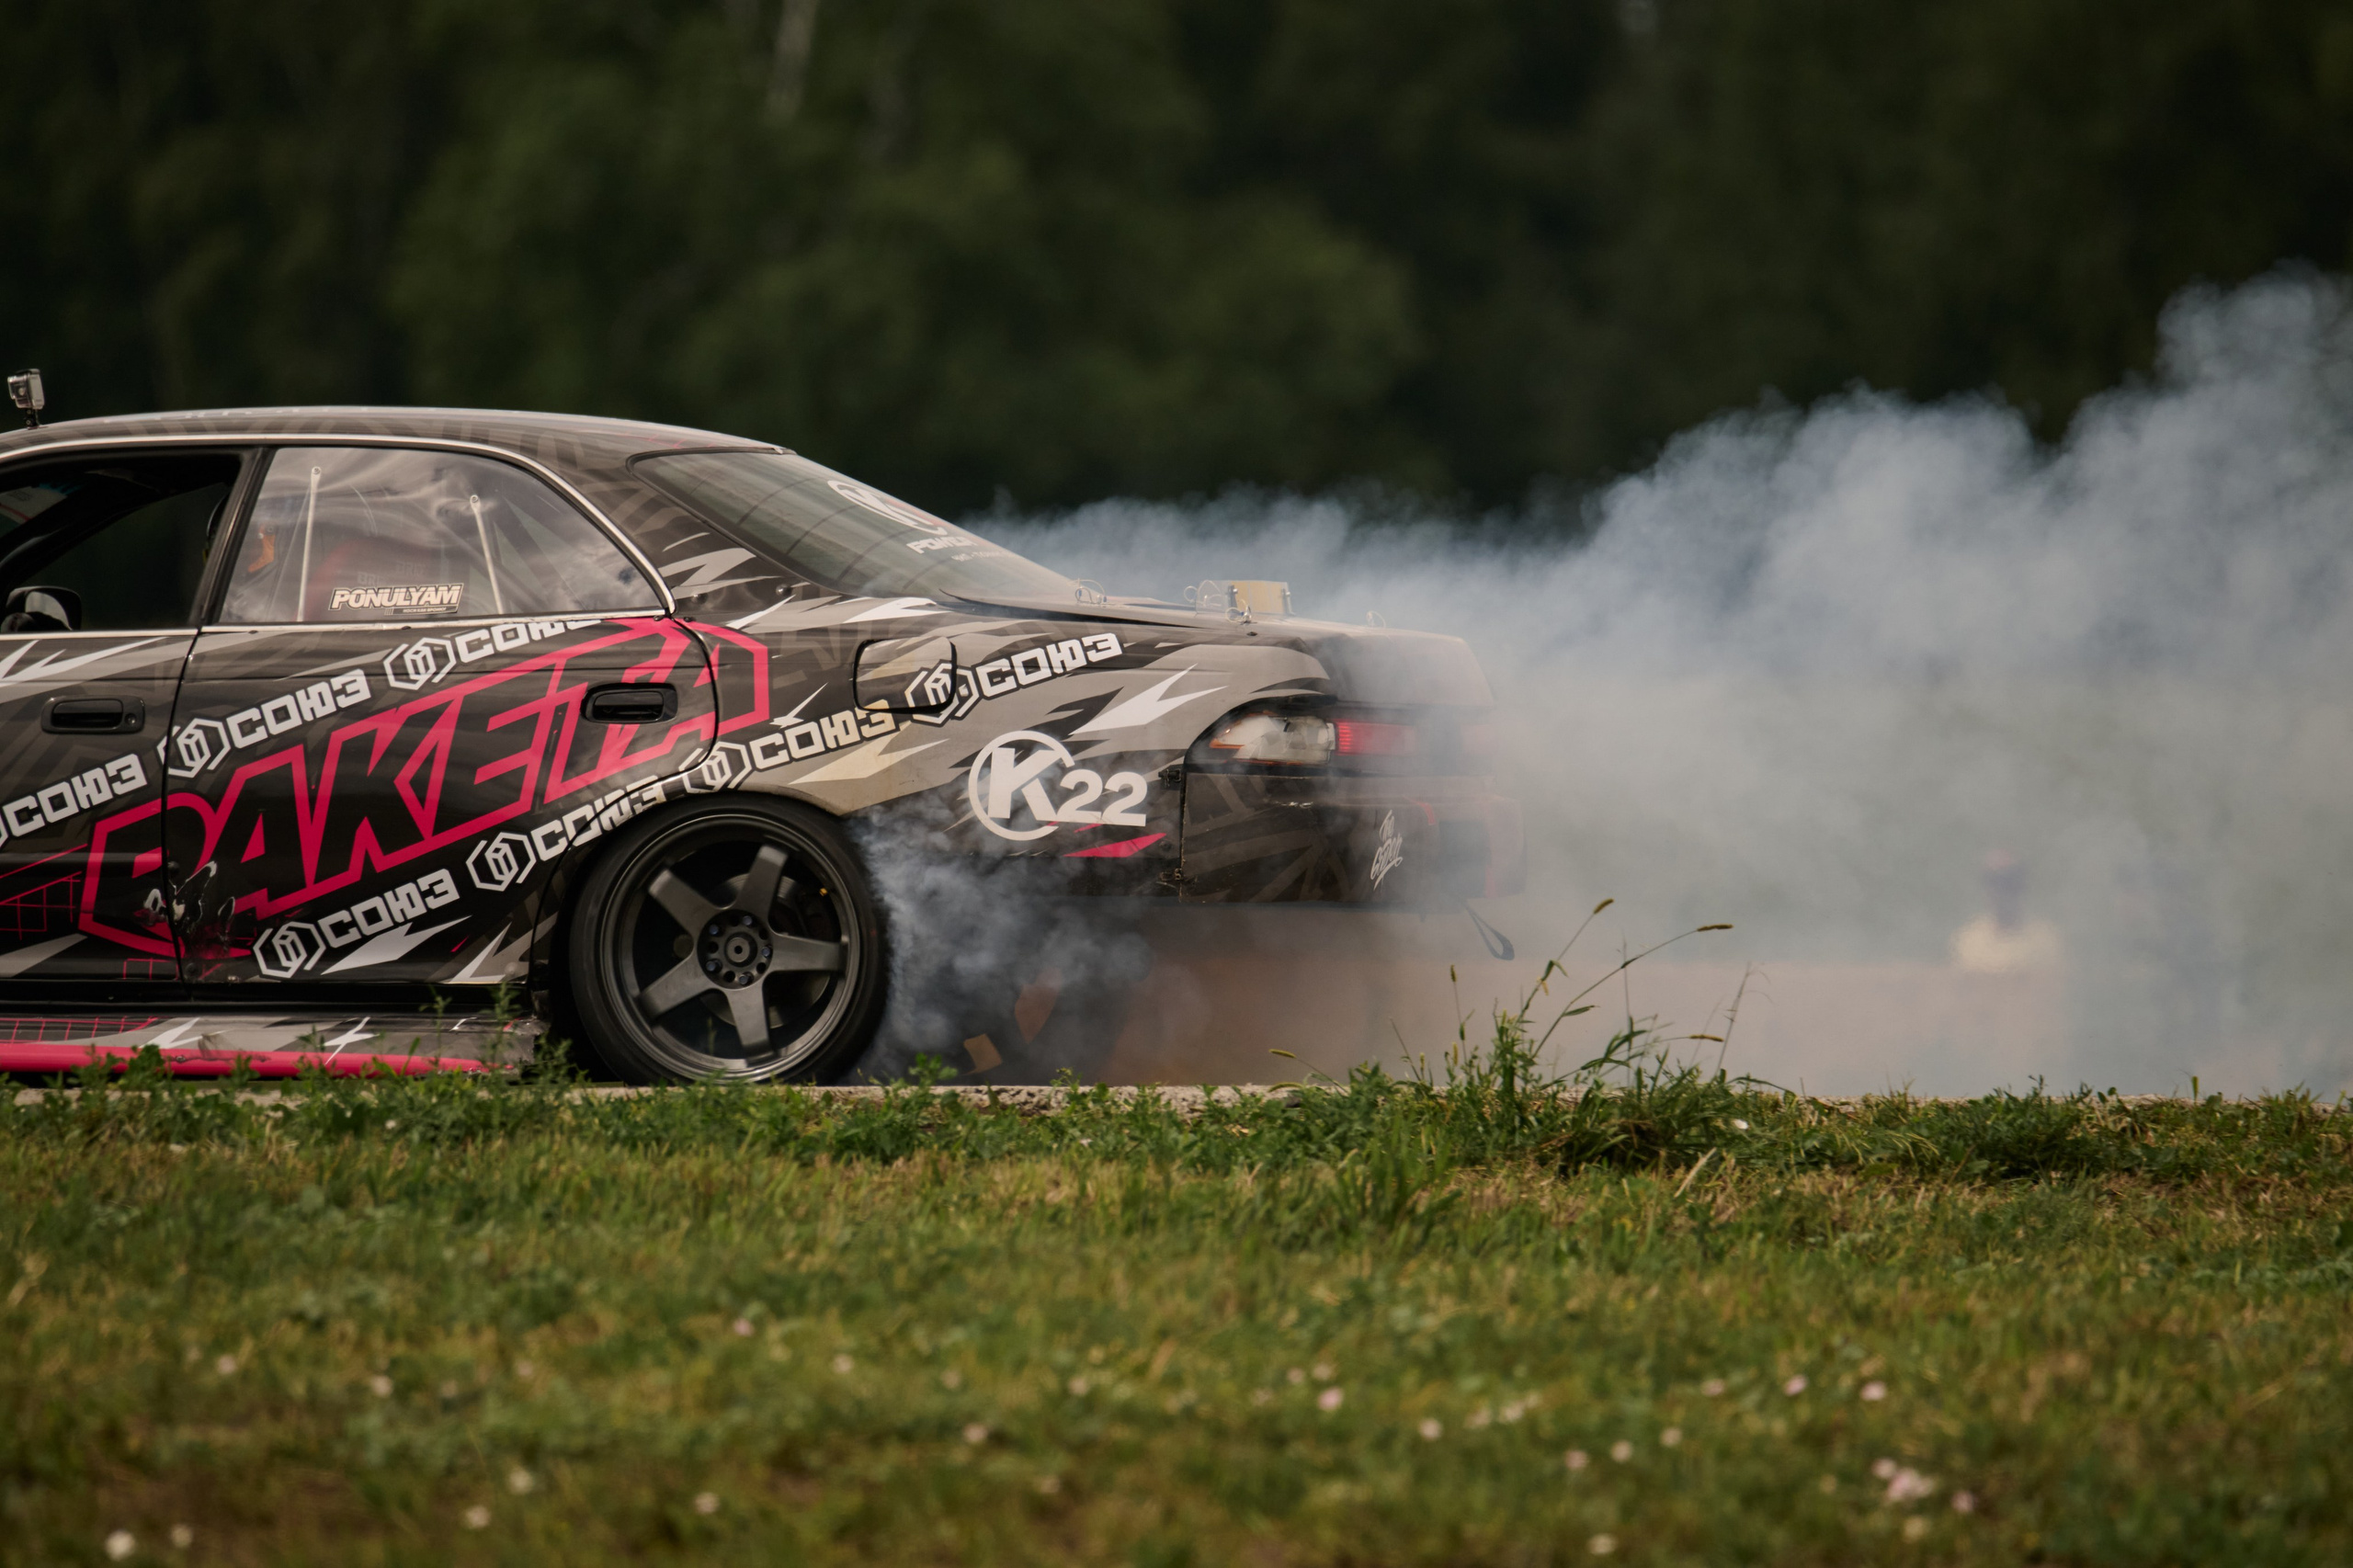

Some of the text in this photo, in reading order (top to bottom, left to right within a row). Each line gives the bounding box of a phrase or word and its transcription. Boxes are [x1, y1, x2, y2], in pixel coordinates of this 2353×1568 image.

[331, 585, 461, 608] PONULYAM
[455, 619, 601, 663] СОЮ
[975, 632, 1122, 698] СОЮЗ
[223, 669, 371, 749] СОЮЗ
[751, 699, 896, 771] СОЮЗ
[2, 753, 148, 837] СОЮЗ
[313, 869, 460, 949] СОЮЗ
